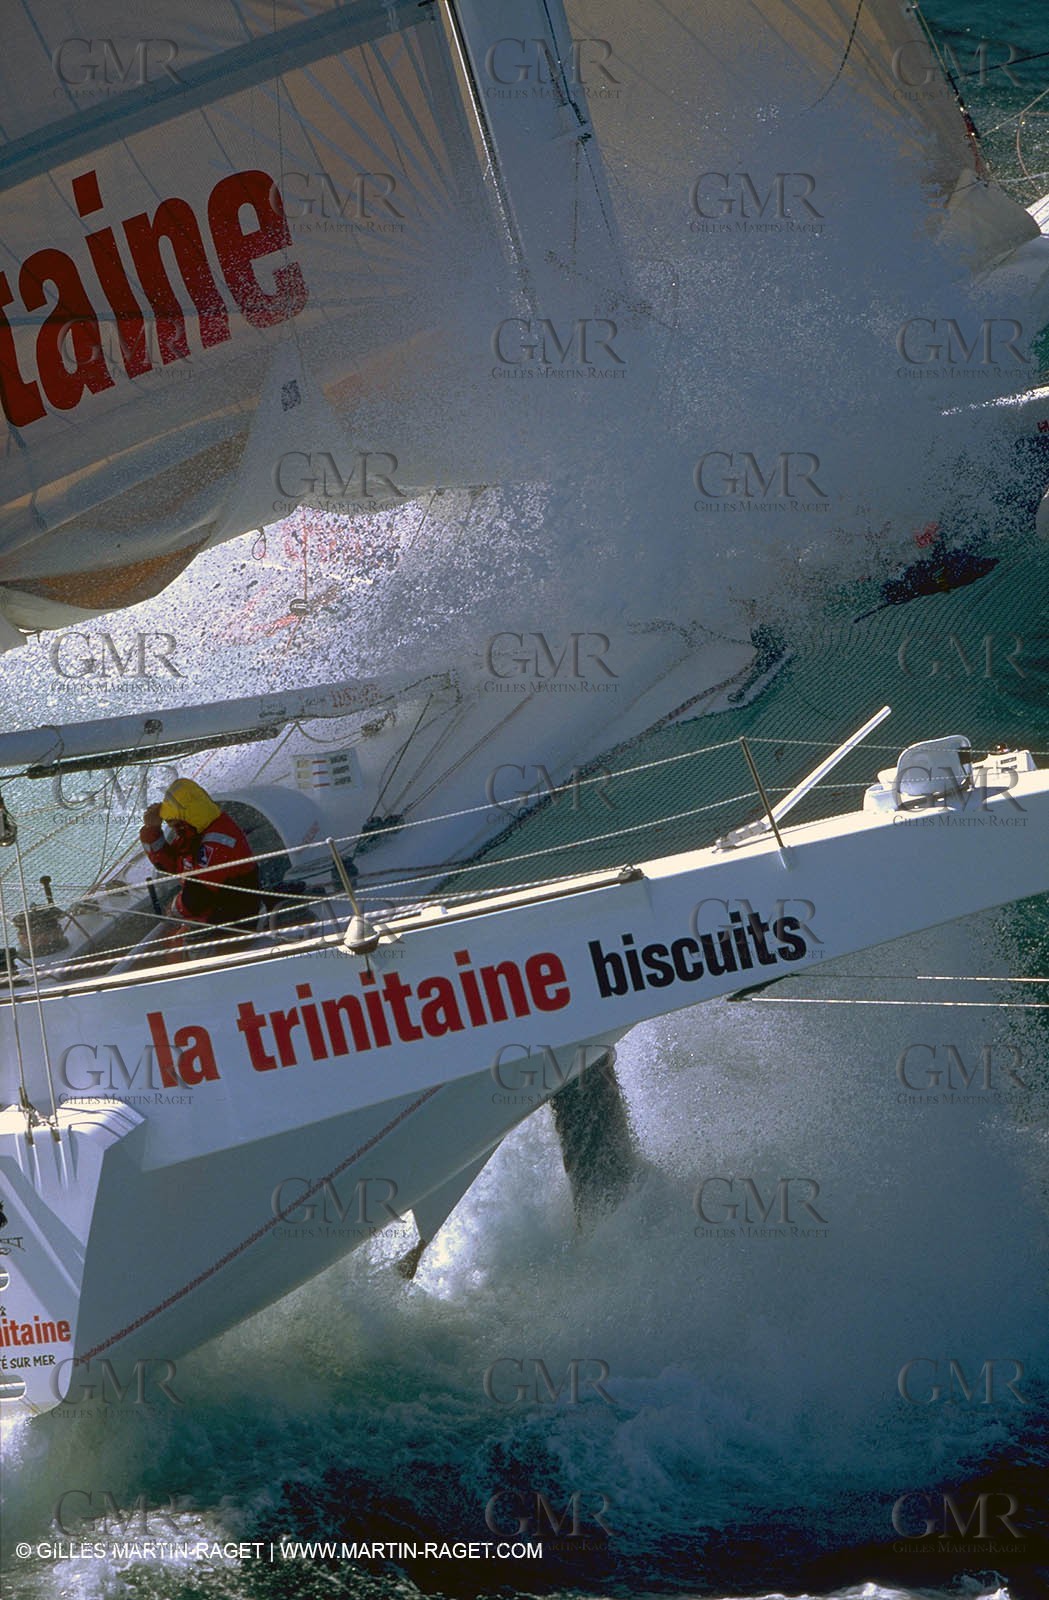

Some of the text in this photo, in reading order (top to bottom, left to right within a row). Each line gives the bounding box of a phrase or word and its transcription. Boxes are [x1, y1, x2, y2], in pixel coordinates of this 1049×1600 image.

[147, 911, 808, 1086] la trinitaine biscuits
[0, 1316, 71, 1347] itaine
[10, 1356, 31, 1369] SUR
[33, 1354, 56, 1368] MER
